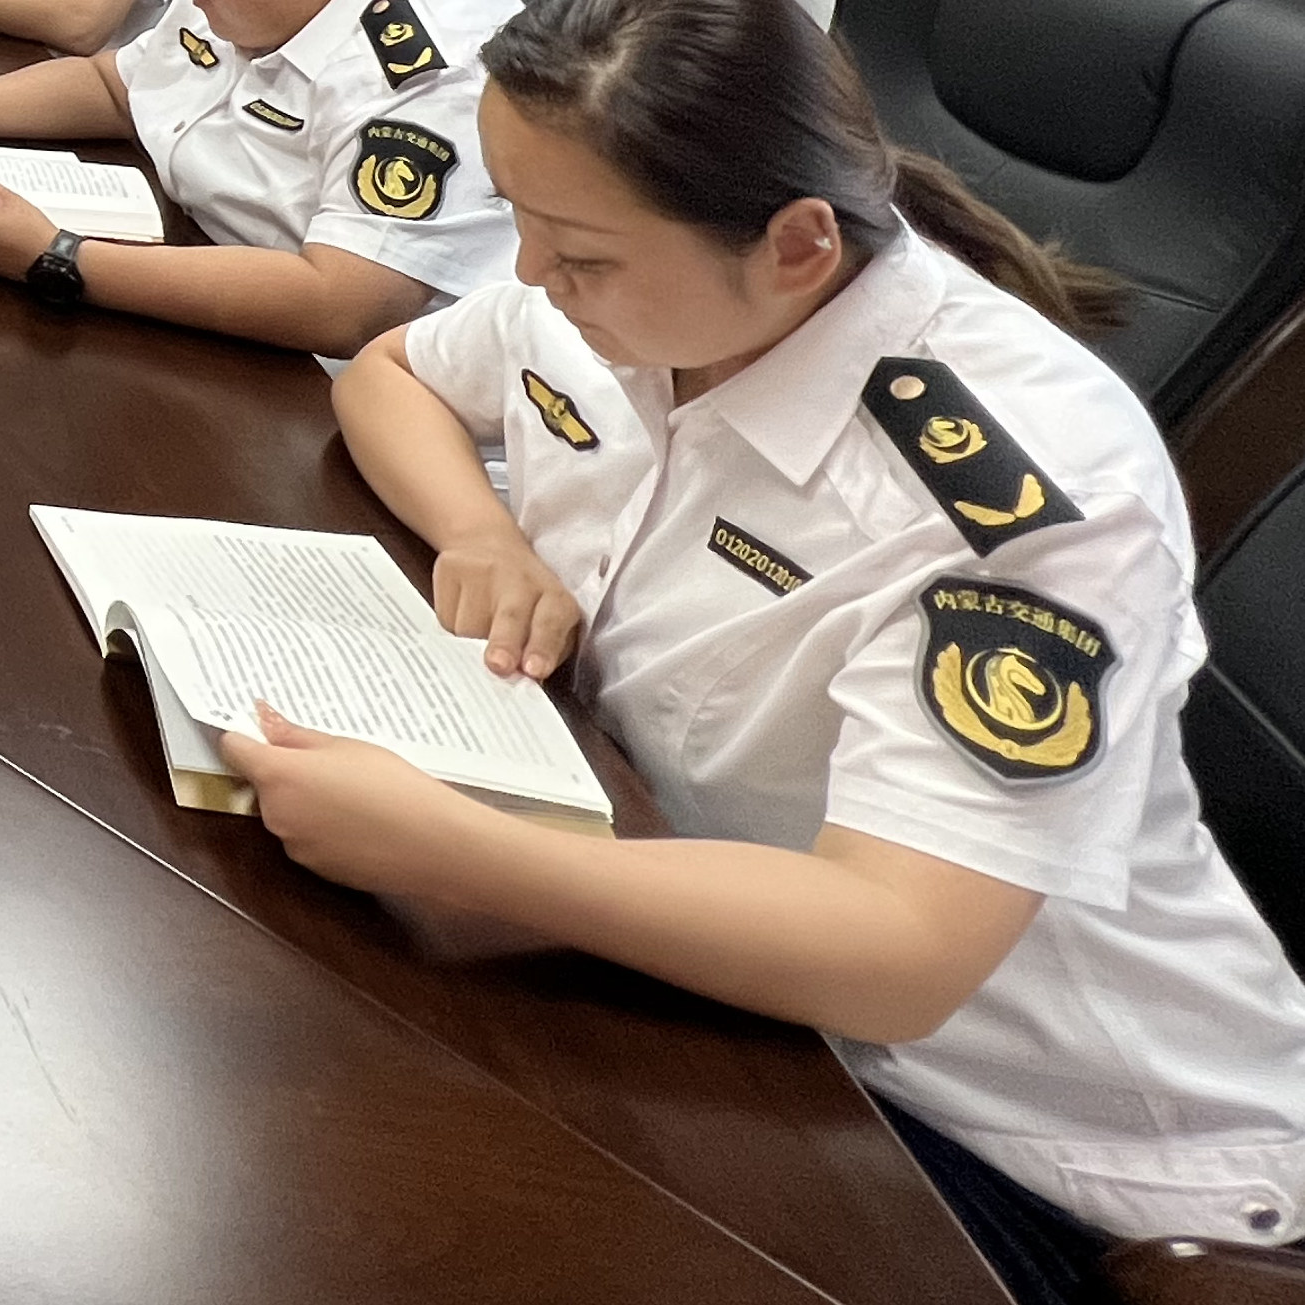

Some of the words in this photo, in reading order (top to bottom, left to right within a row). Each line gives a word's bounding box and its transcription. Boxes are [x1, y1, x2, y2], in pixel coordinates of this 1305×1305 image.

[933, 589, 1102, 658] 内蒙古交通集团
